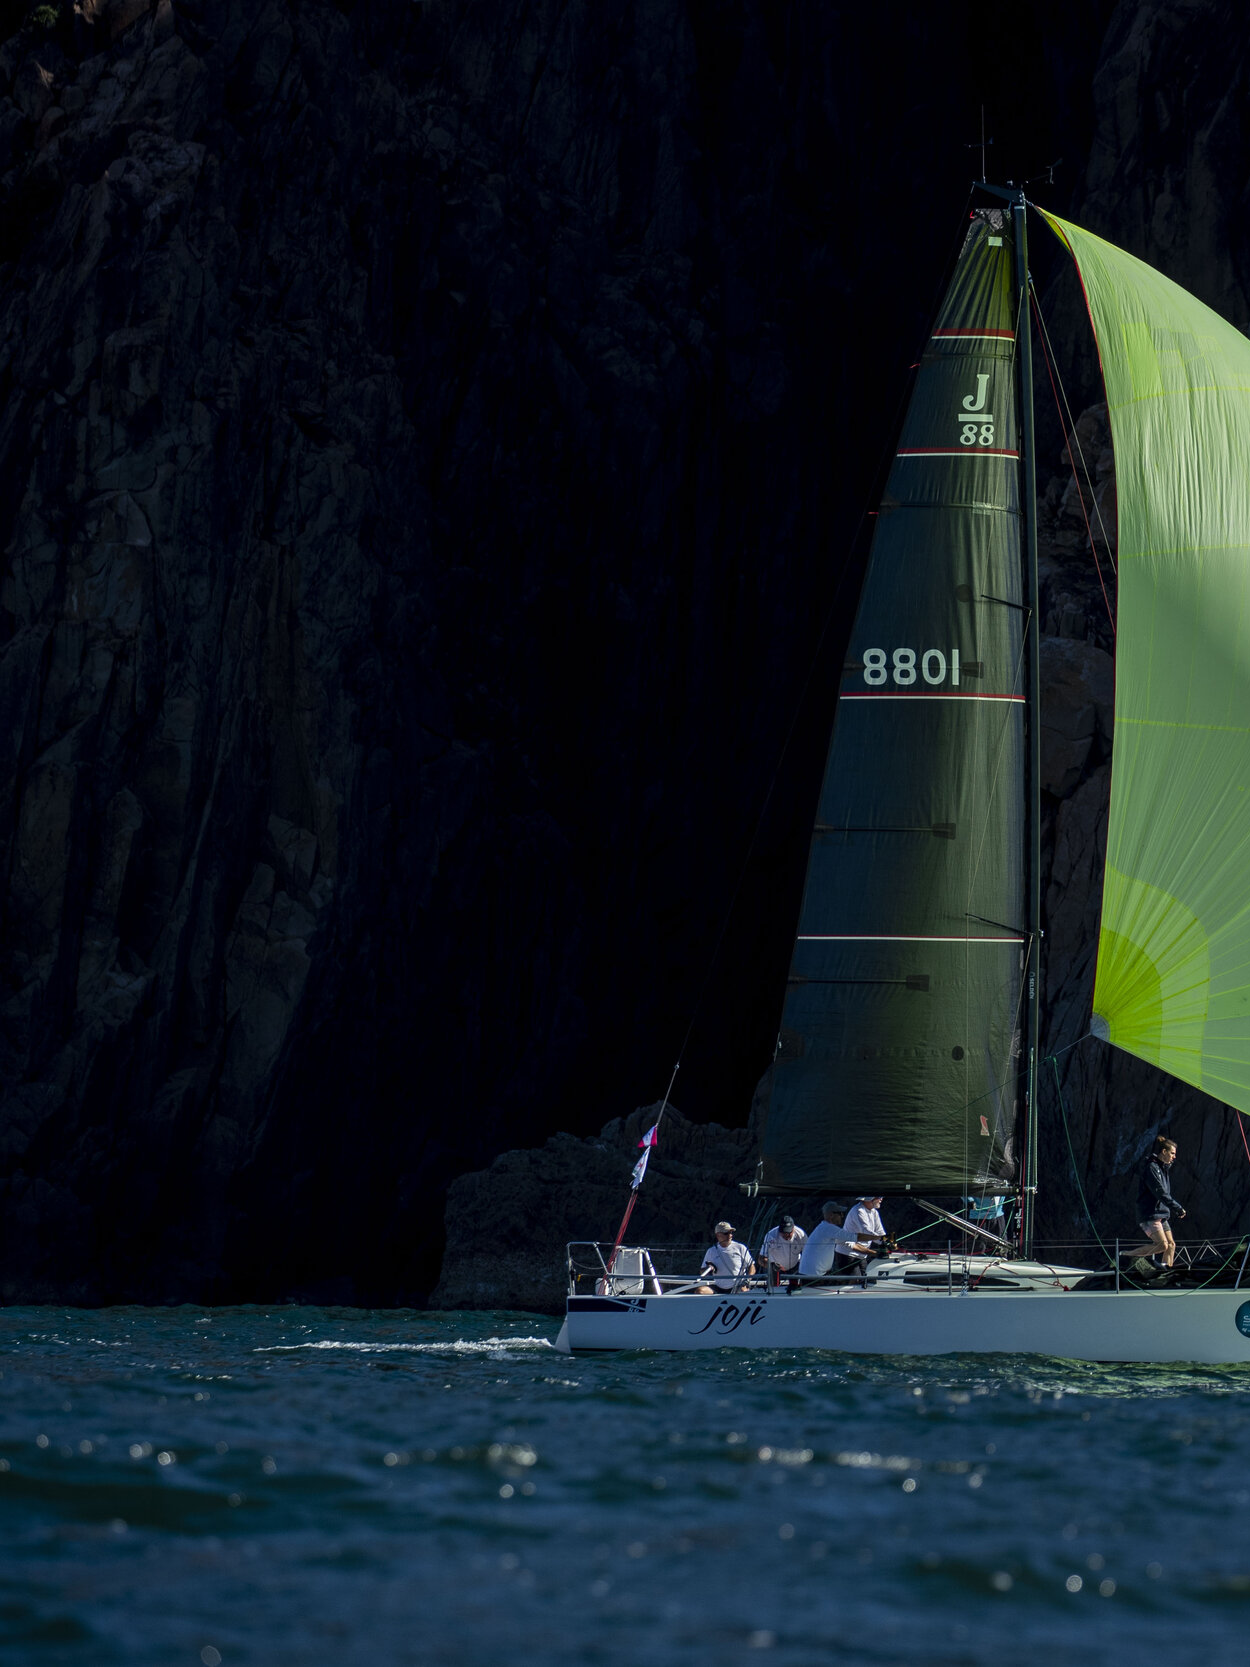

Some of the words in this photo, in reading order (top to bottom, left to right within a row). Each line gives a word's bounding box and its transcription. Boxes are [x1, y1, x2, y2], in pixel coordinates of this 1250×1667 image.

[962, 373, 990, 412] J
[959, 423, 995, 446] 88
[862, 647, 960, 686] 8801
[687, 1299, 768, 1335] joji
